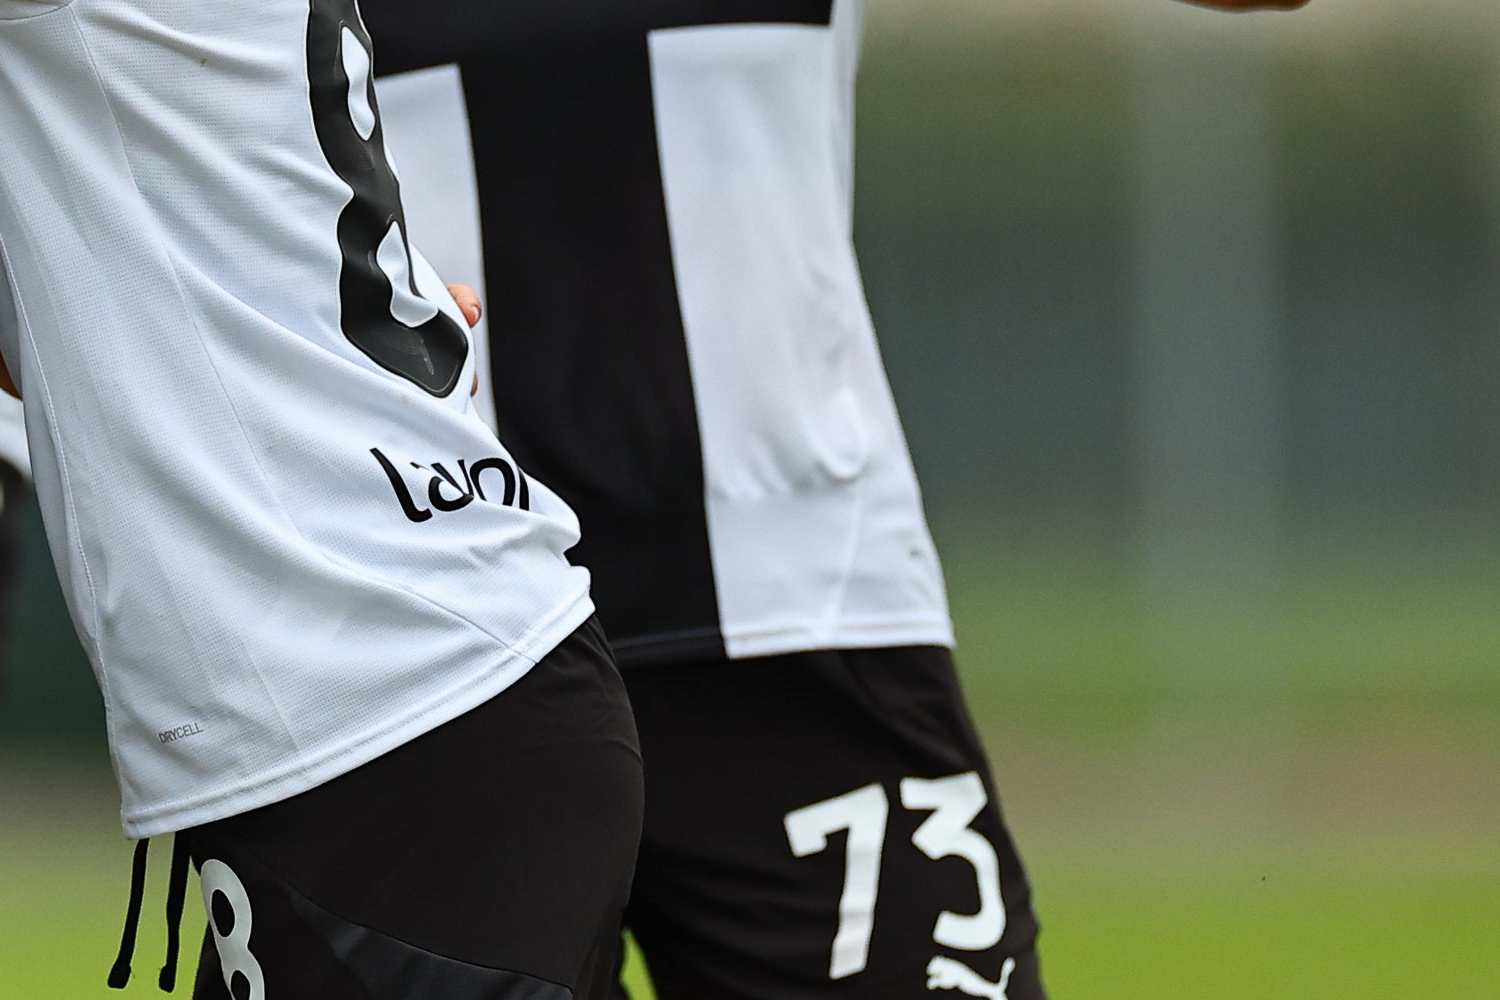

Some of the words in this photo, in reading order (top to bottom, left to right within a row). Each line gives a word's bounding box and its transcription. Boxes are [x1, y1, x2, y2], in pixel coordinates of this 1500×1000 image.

[158, 722, 204, 743] DRYCELL
[200, 859, 266, 1000] 8
[783, 770, 1008, 970] 73
